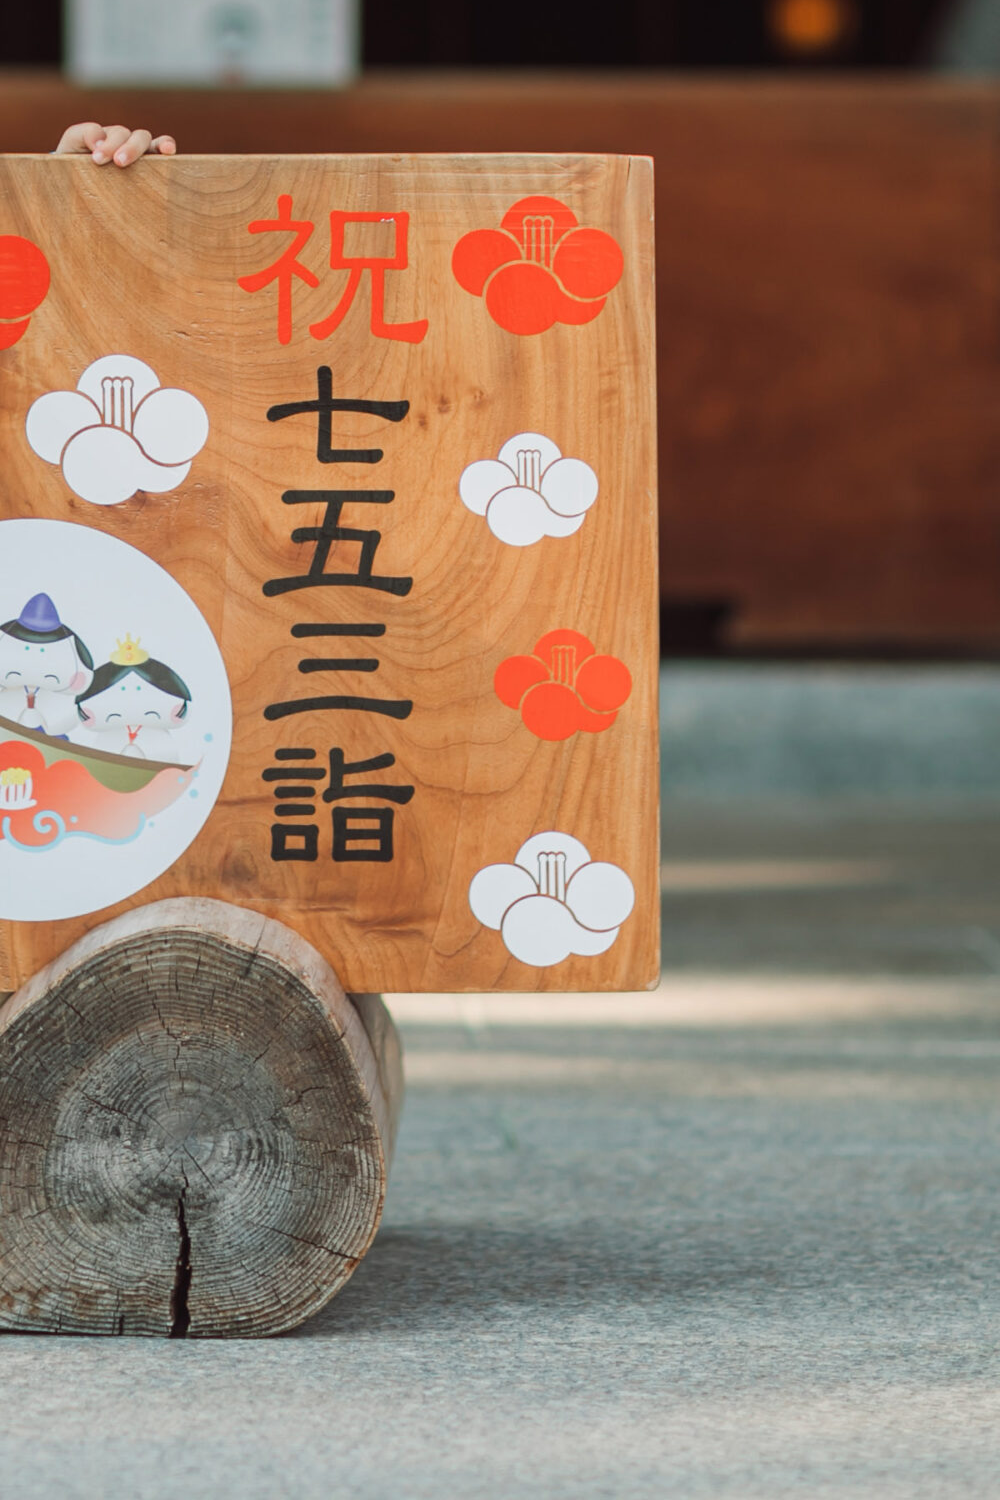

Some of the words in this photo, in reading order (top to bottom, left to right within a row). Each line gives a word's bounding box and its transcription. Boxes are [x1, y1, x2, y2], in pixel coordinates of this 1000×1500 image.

[238, 195, 429, 345] 祝
[262, 365, 414, 862] 七五三詣
